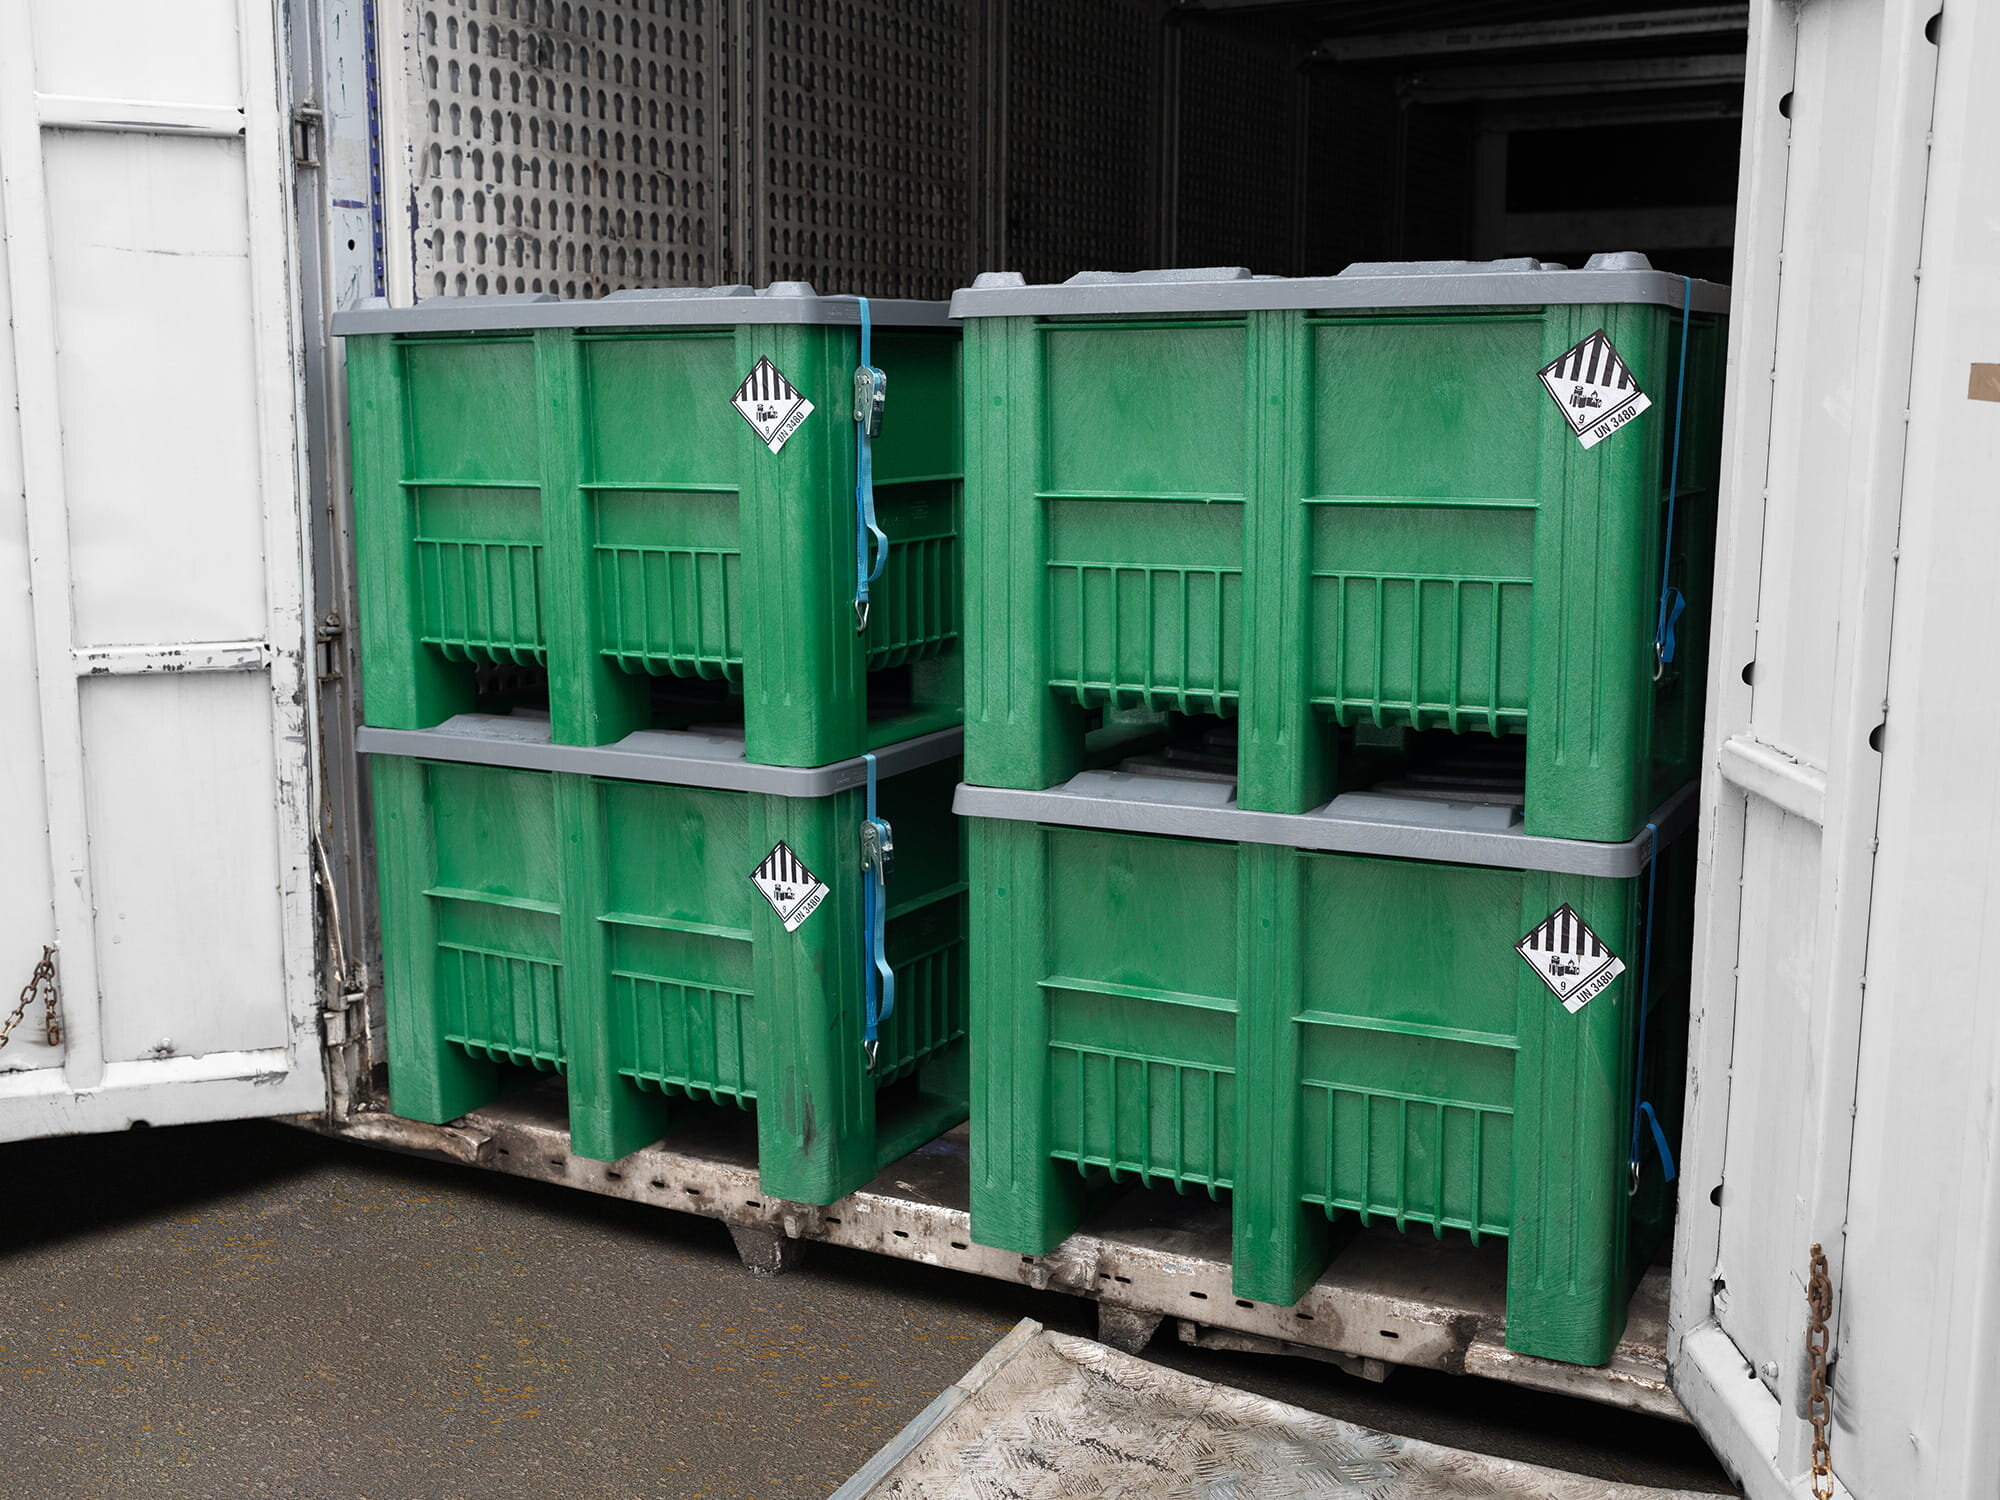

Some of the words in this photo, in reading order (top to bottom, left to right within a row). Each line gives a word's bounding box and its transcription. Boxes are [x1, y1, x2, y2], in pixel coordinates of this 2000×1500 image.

[777, 428, 789, 443] UN
[786, 411, 805, 431] 3480
[1578, 414, 1585, 424] 9
[1594, 422, 1611, 439] UN
[1611, 405, 1637, 428] 3480
[794, 911, 805, 924] UN
[803, 895, 821, 914] 3480
[1560, 981, 1566, 991] 9
[1576, 988, 1593, 1003] UN
[1591, 970, 1614, 992] 3480
